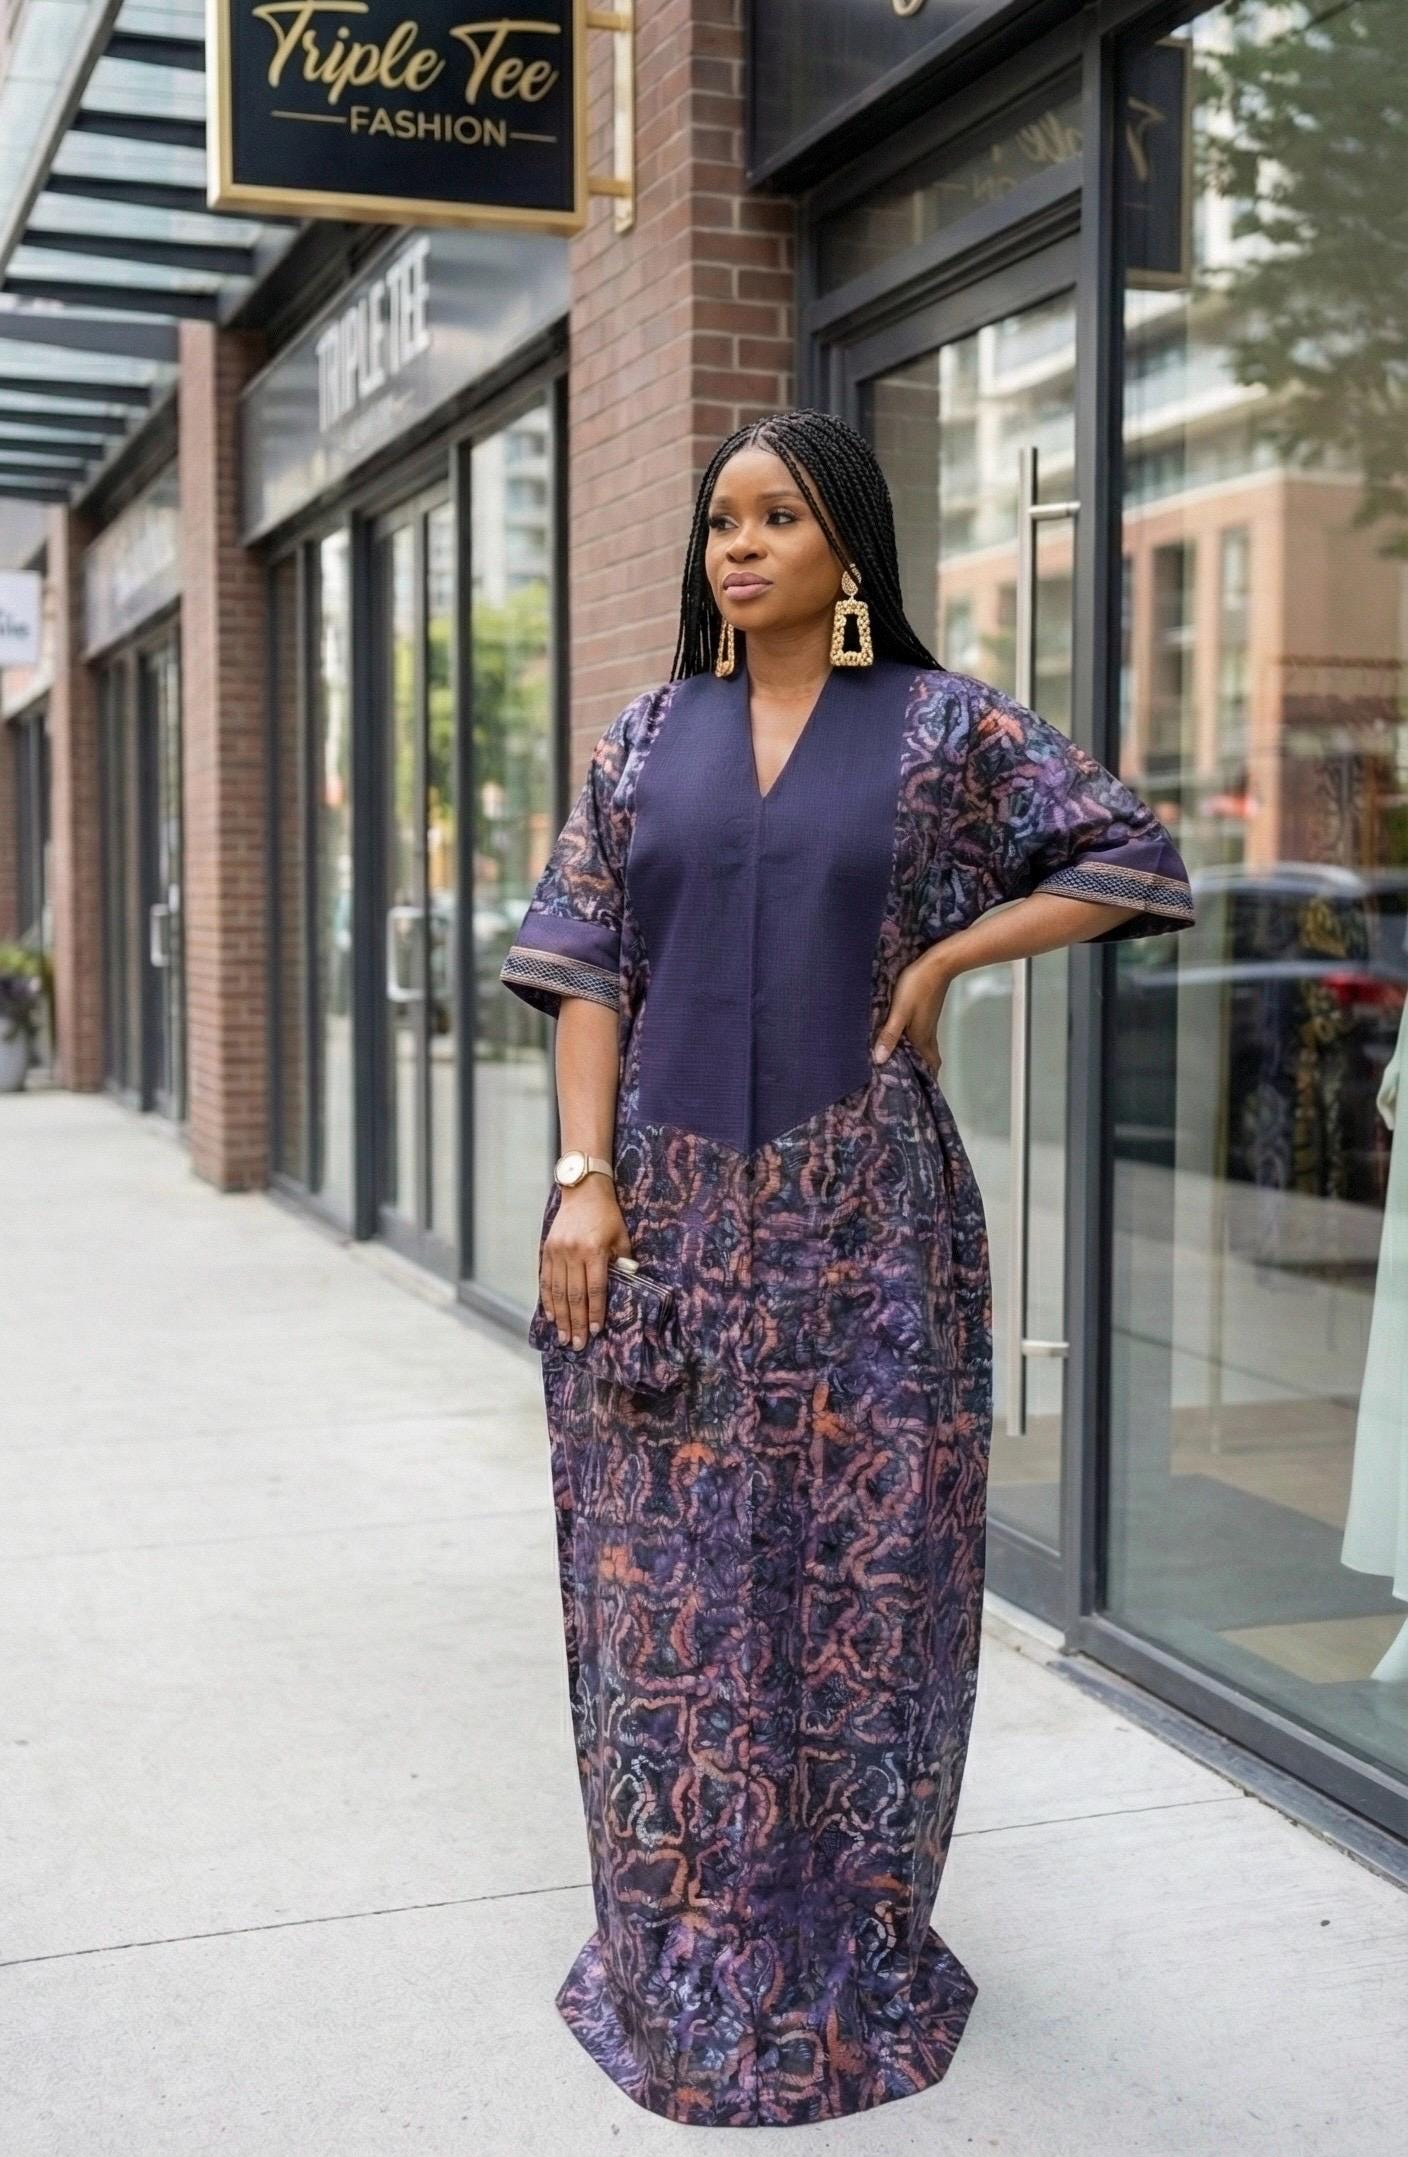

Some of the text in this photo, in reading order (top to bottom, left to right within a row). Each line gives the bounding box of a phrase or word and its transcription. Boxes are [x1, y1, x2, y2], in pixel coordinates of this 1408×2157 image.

[252, 0, 562, 105] Triple Tee
[349, 105, 508, 147] FASHION
